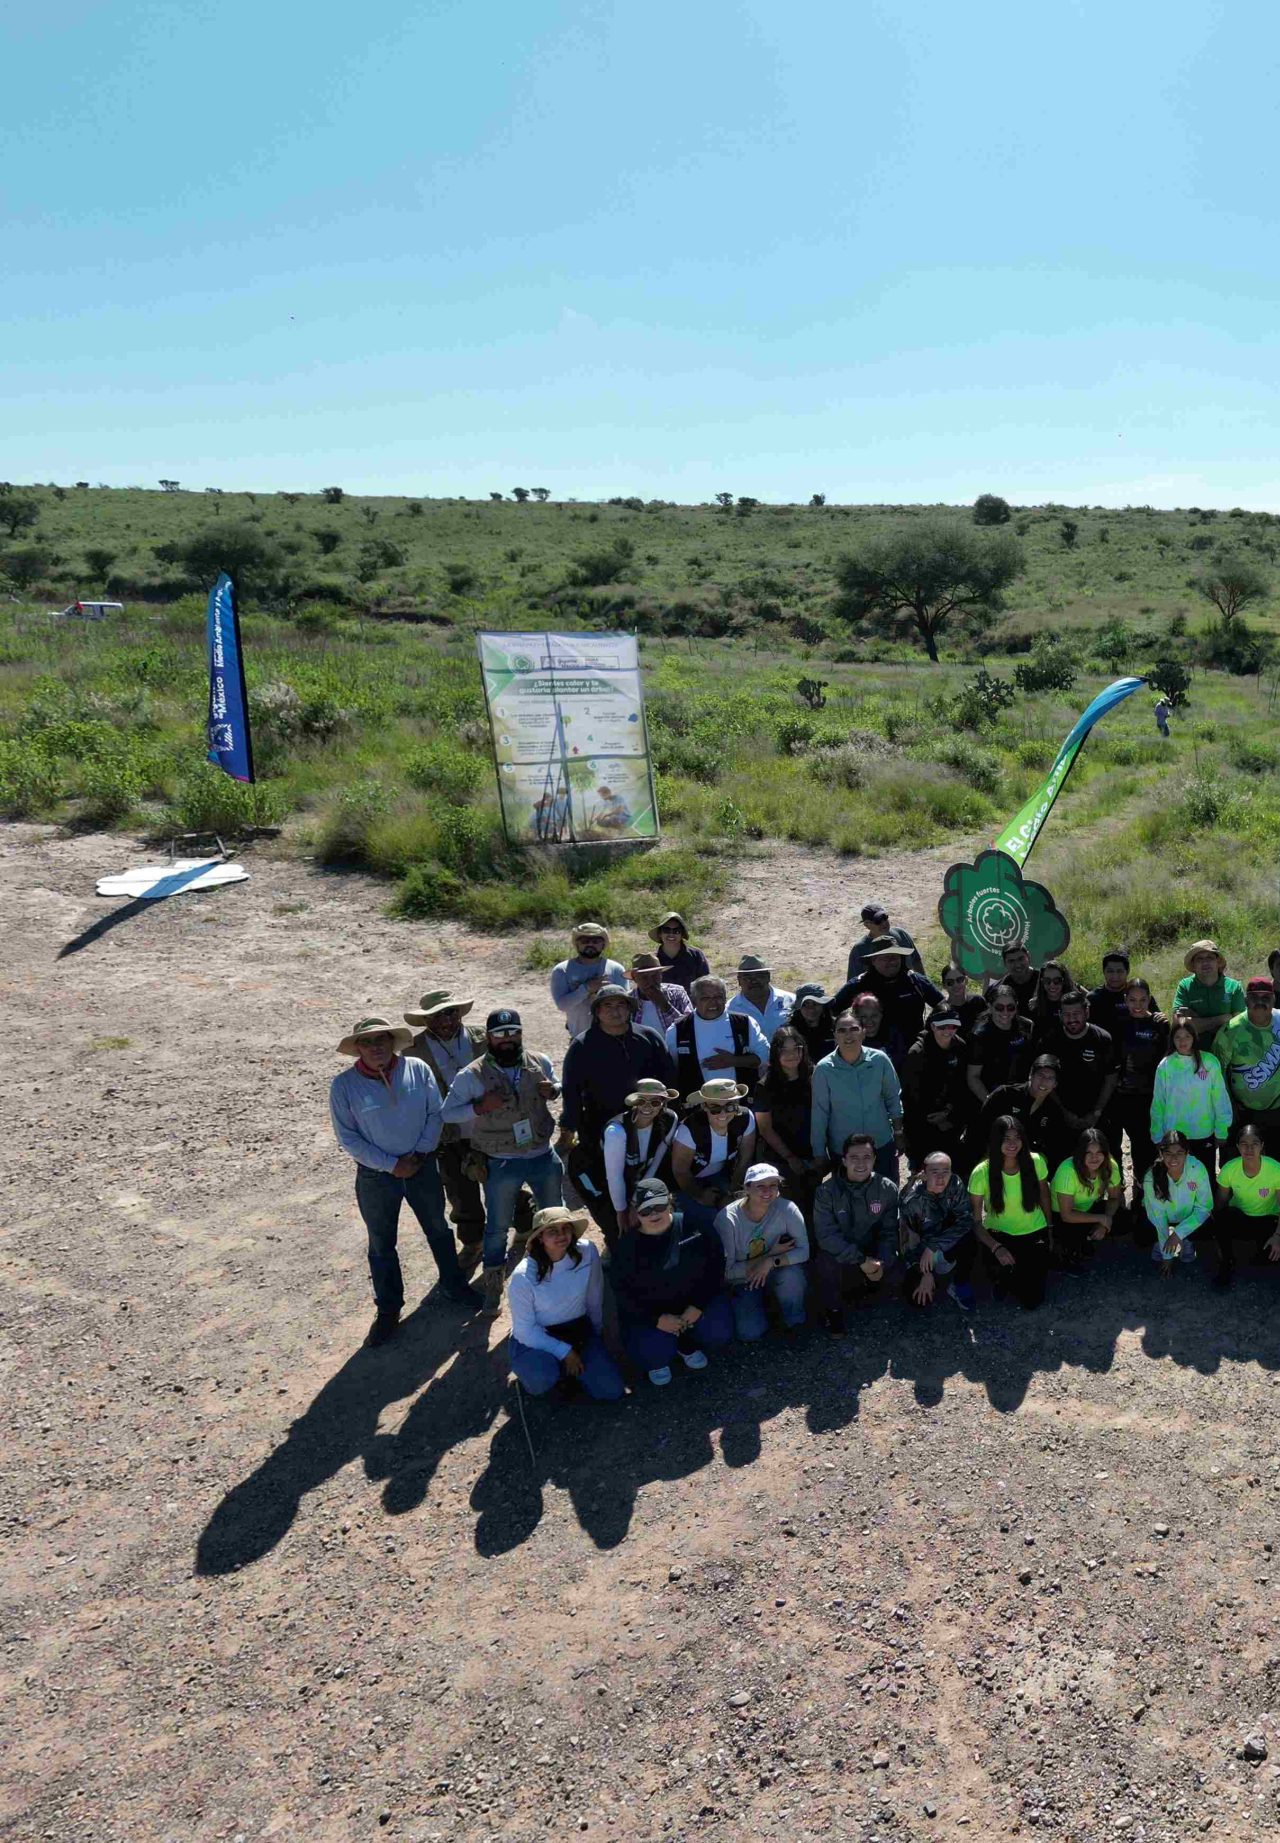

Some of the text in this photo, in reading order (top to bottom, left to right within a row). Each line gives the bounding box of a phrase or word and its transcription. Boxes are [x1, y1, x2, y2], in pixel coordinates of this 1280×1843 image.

[216, 676, 227, 714] México
[503, 736, 510, 744] 3
[966, 886, 1000, 923] Árboles fuertes
